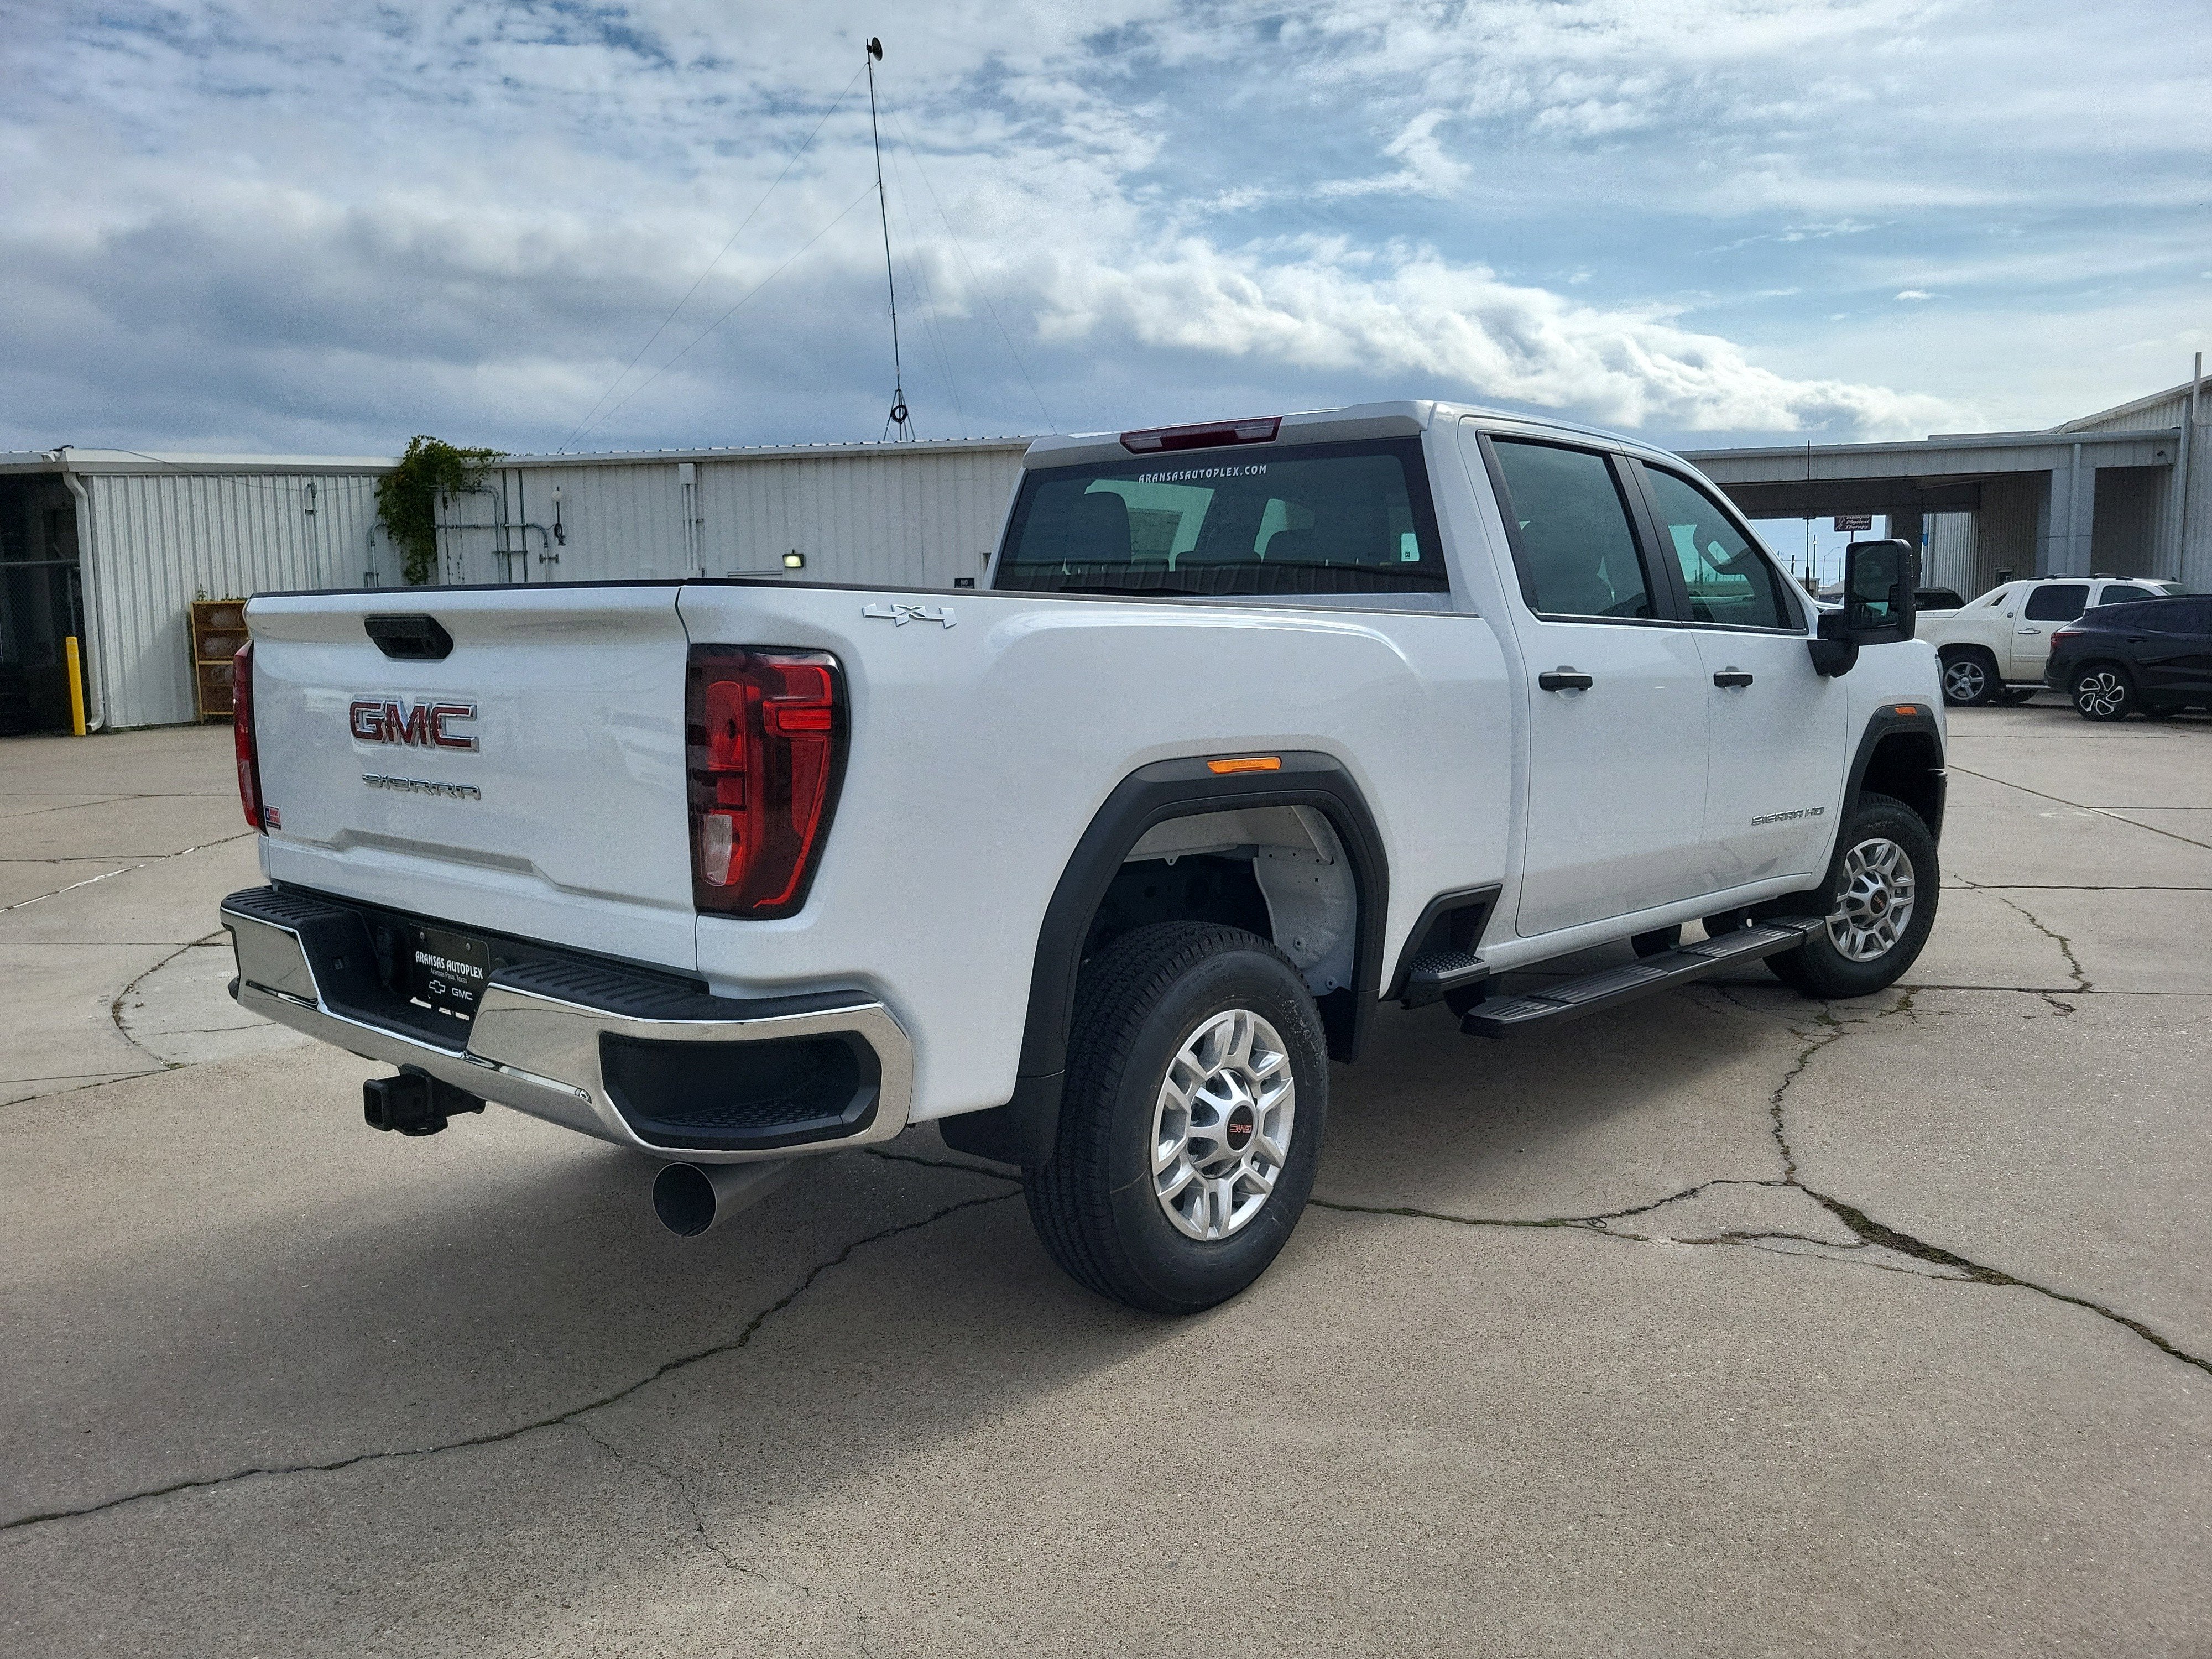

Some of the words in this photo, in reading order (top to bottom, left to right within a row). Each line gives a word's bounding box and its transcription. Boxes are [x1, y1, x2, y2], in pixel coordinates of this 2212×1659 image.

[1138, 465, 1267, 484] ARANSASAUTOPLEX.COM
[349, 699, 480, 753] GMC
[362, 773, 481, 800] SIERRA
[1751, 809, 1803, 826] SIERRA
[1804, 806, 1824, 817] HD
[415, 951, 445, 969] ARANSAS
[446, 959, 483, 979] AUTOPLEX
[456, 974, 468, 984] Texas
[452, 988, 473, 1001] GMC
[1229, 1124, 1252, 1133] GMC
